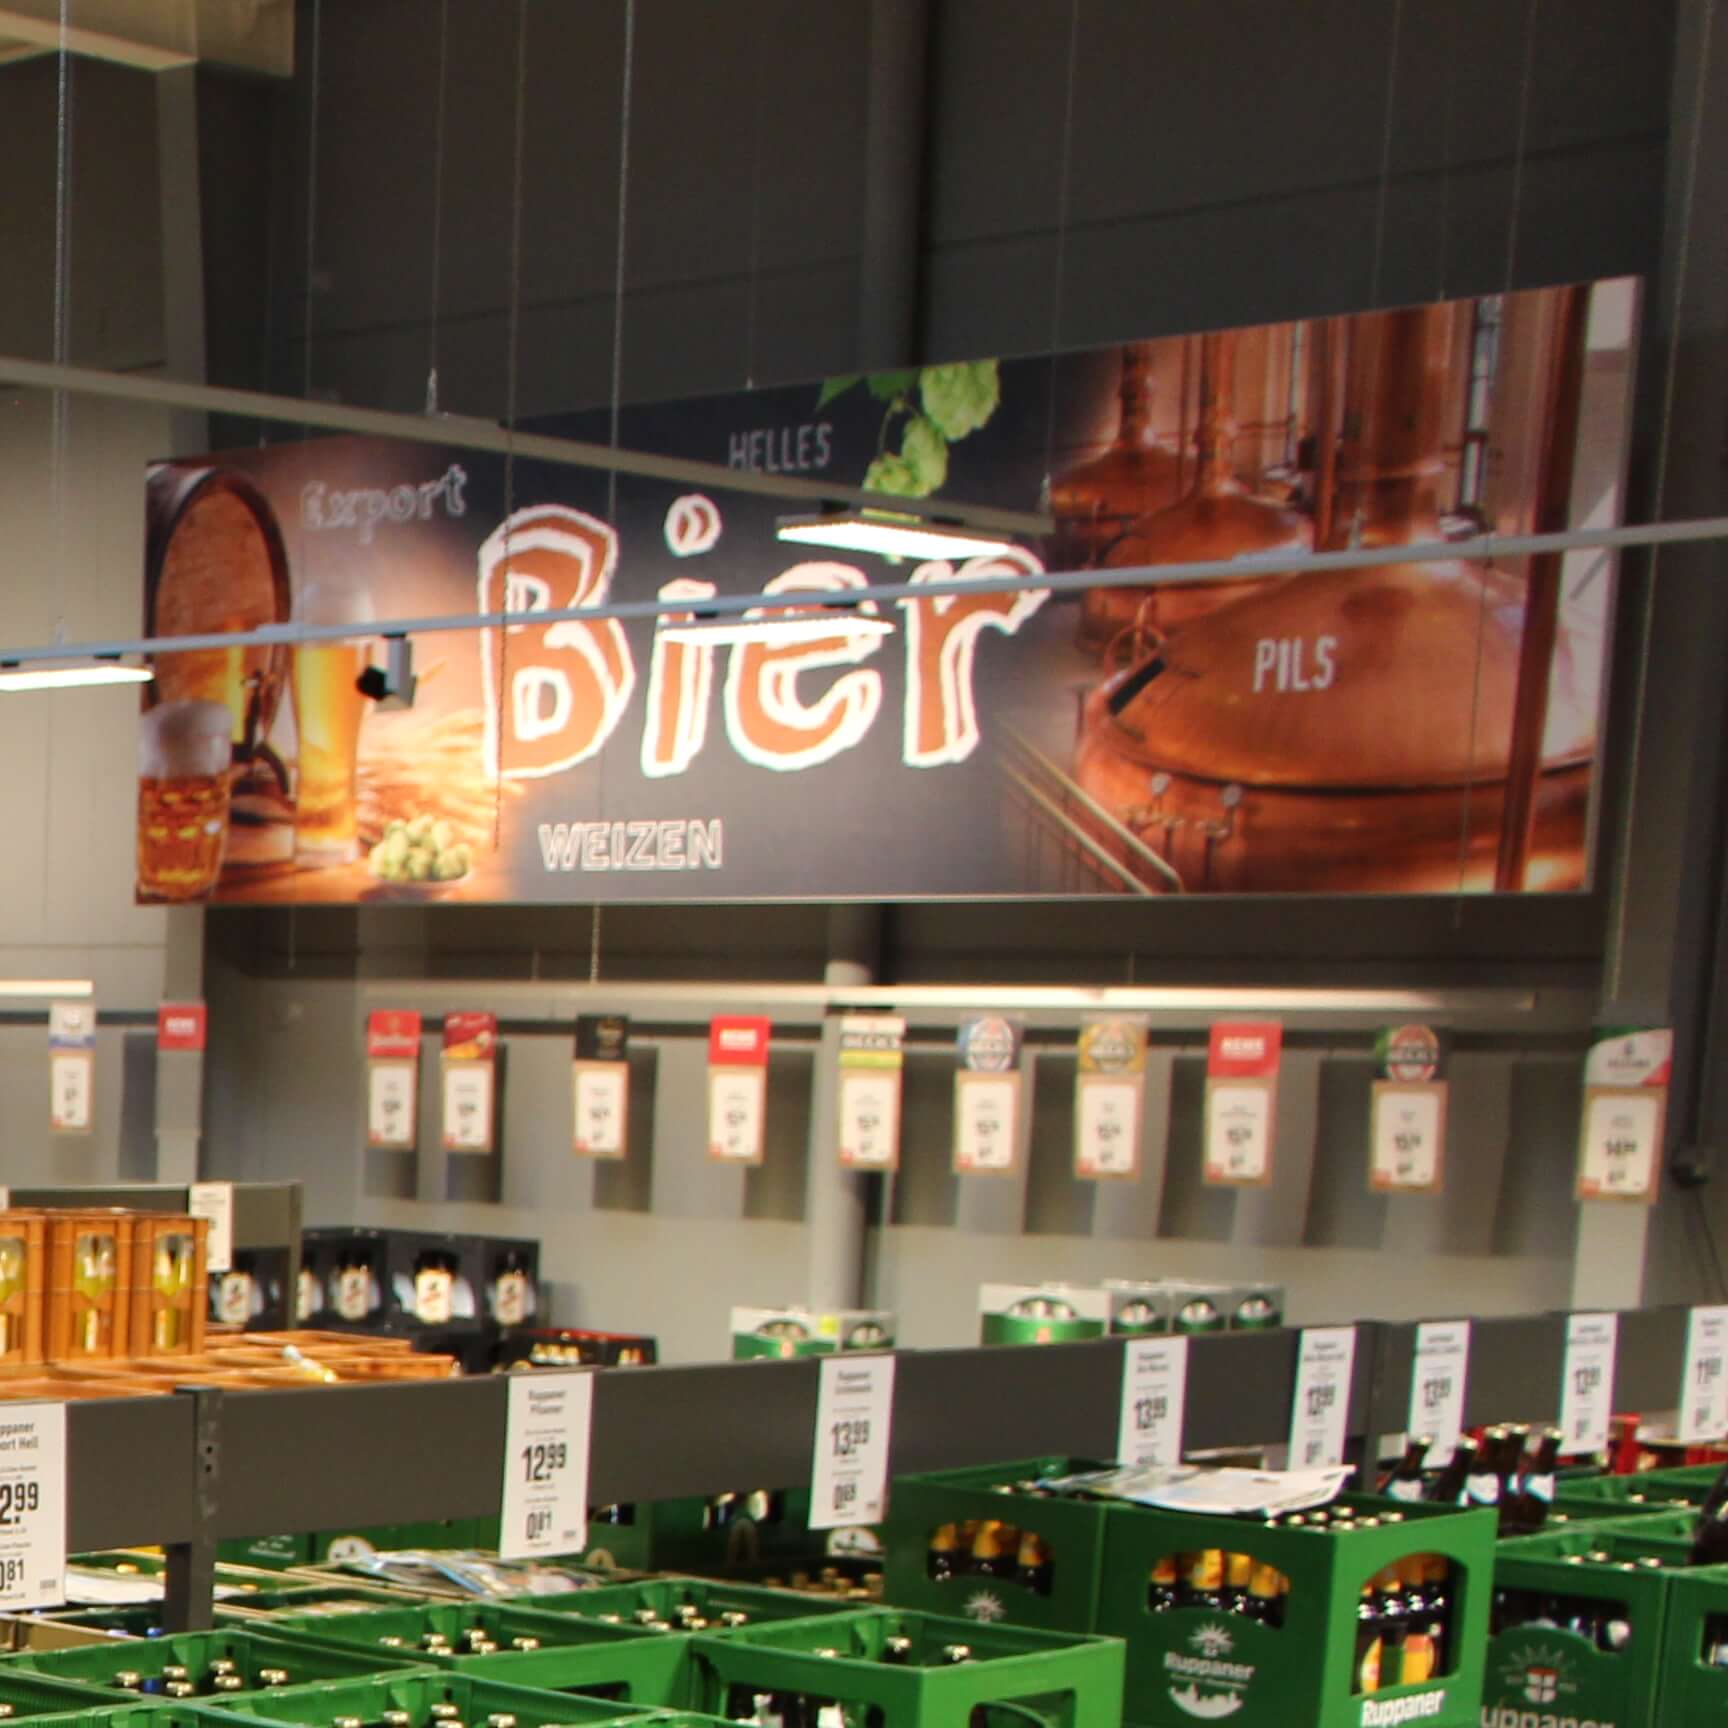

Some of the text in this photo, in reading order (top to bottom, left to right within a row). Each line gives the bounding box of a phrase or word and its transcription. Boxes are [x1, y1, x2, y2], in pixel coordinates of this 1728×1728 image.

[727, 422, 833, 476] HELLES
[301, 461, 468, 543] Export
[478, 495, 1052, 782] Bier
[1252, 634, 1339, 695] PILS
[537, 817, 724, 872] WEIZEN
